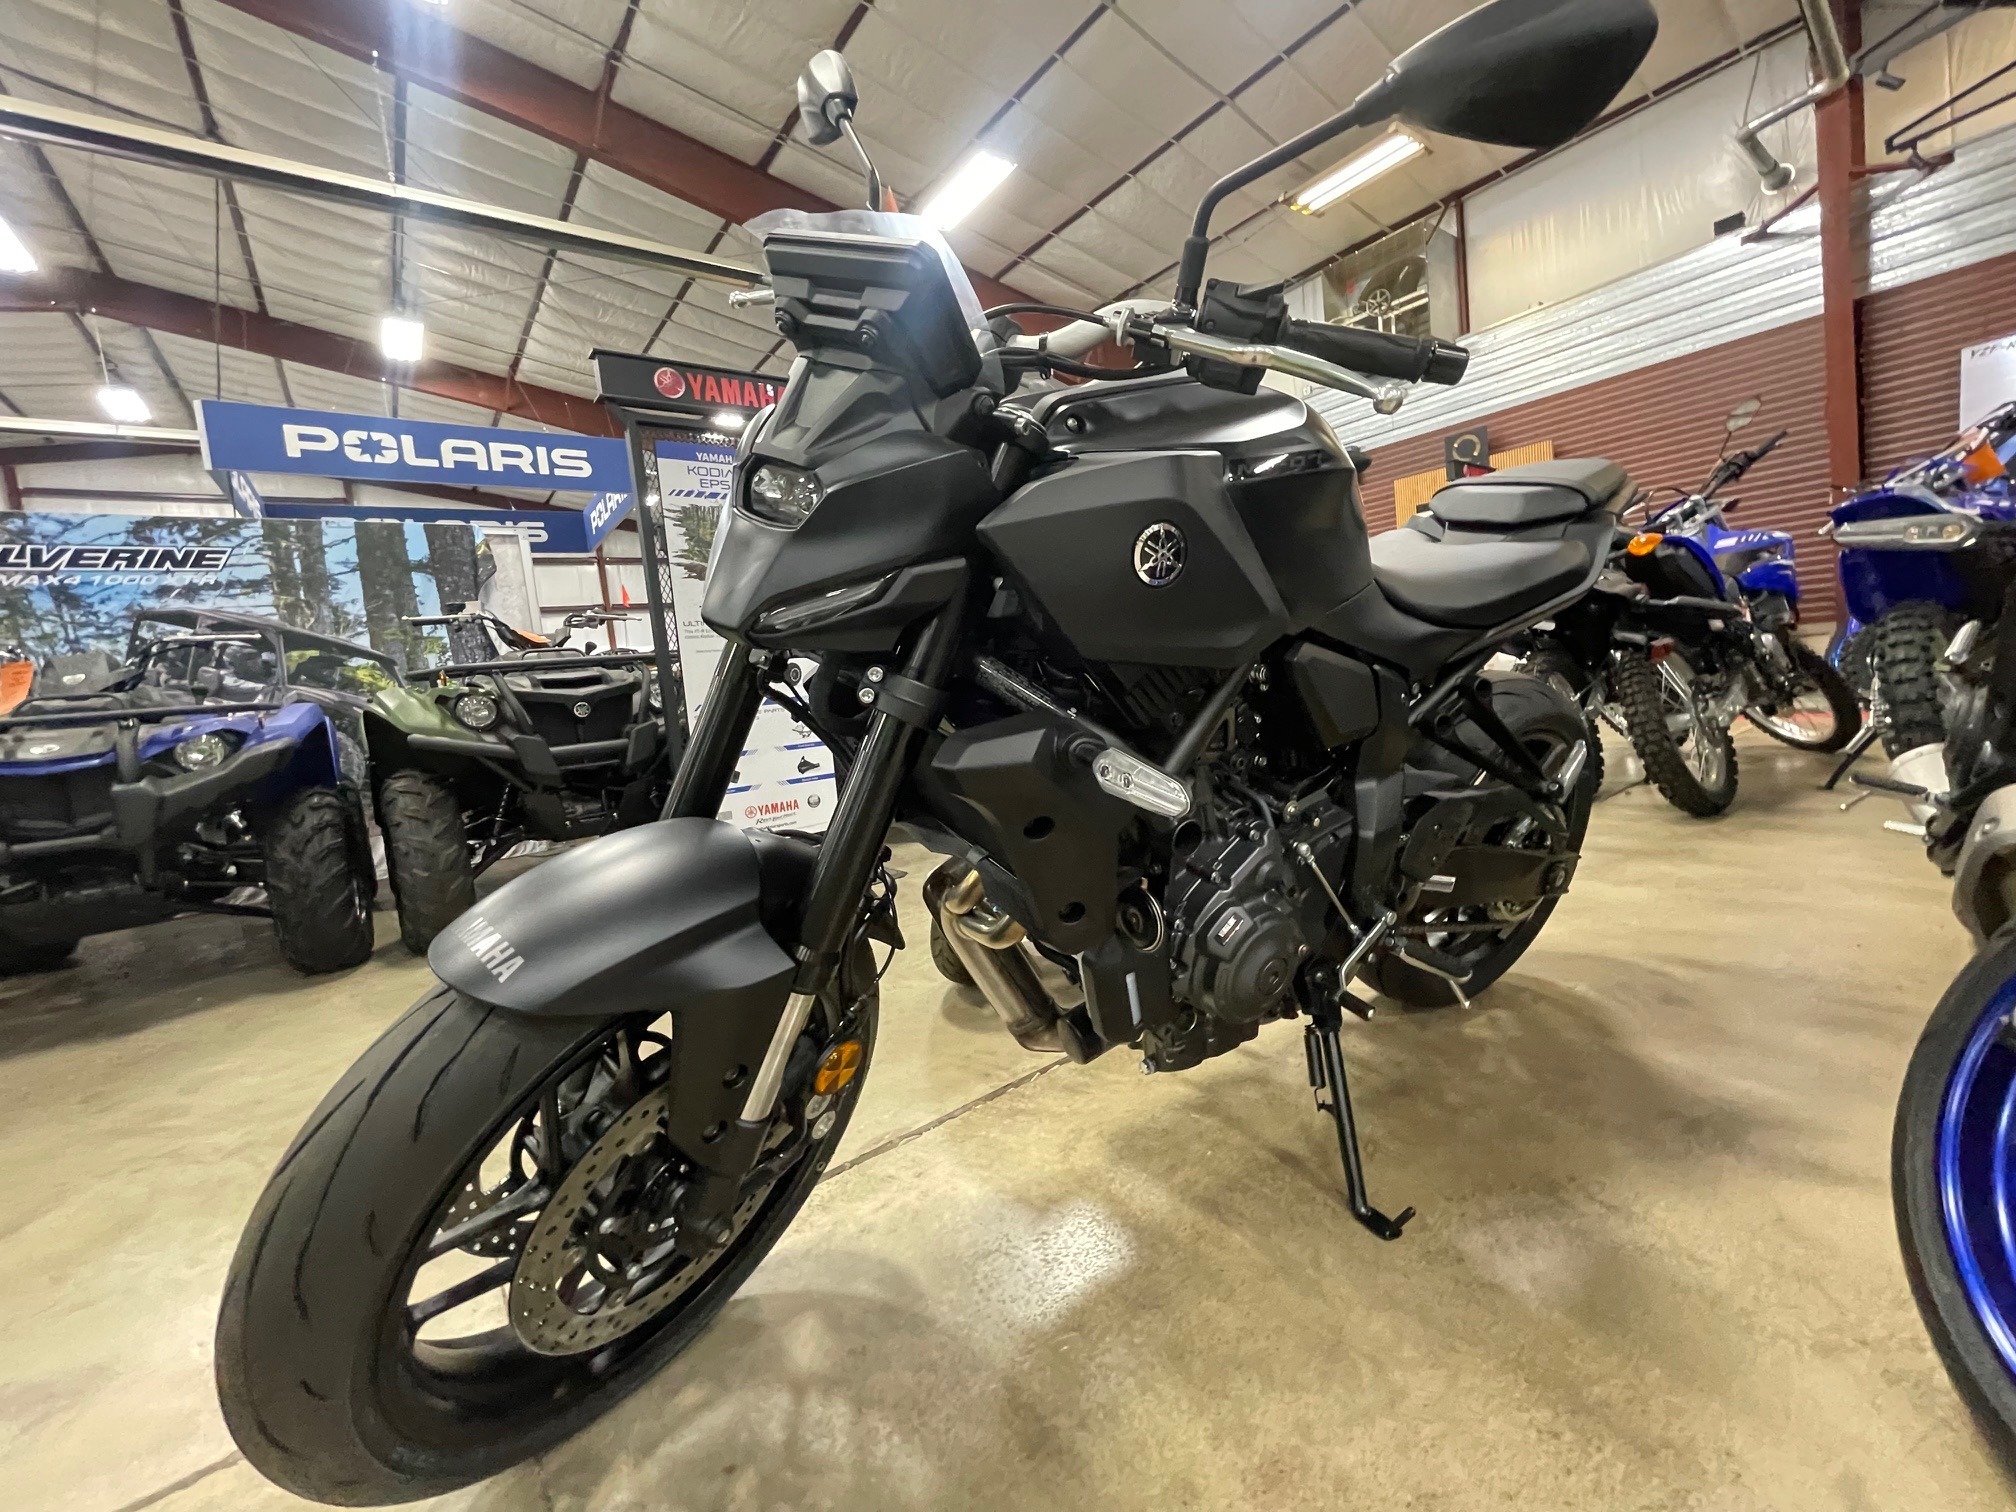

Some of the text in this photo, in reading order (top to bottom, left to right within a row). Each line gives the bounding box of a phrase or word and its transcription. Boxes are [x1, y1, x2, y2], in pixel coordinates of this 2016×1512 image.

[282, 424, 593, 478] POLARIS
[700, 479, 731, 490] EPS
[590, 492, 628, 535] POLAR
[91, 575, 157, 586] 1000
[757, 799, 799, 816] YAMAHA
